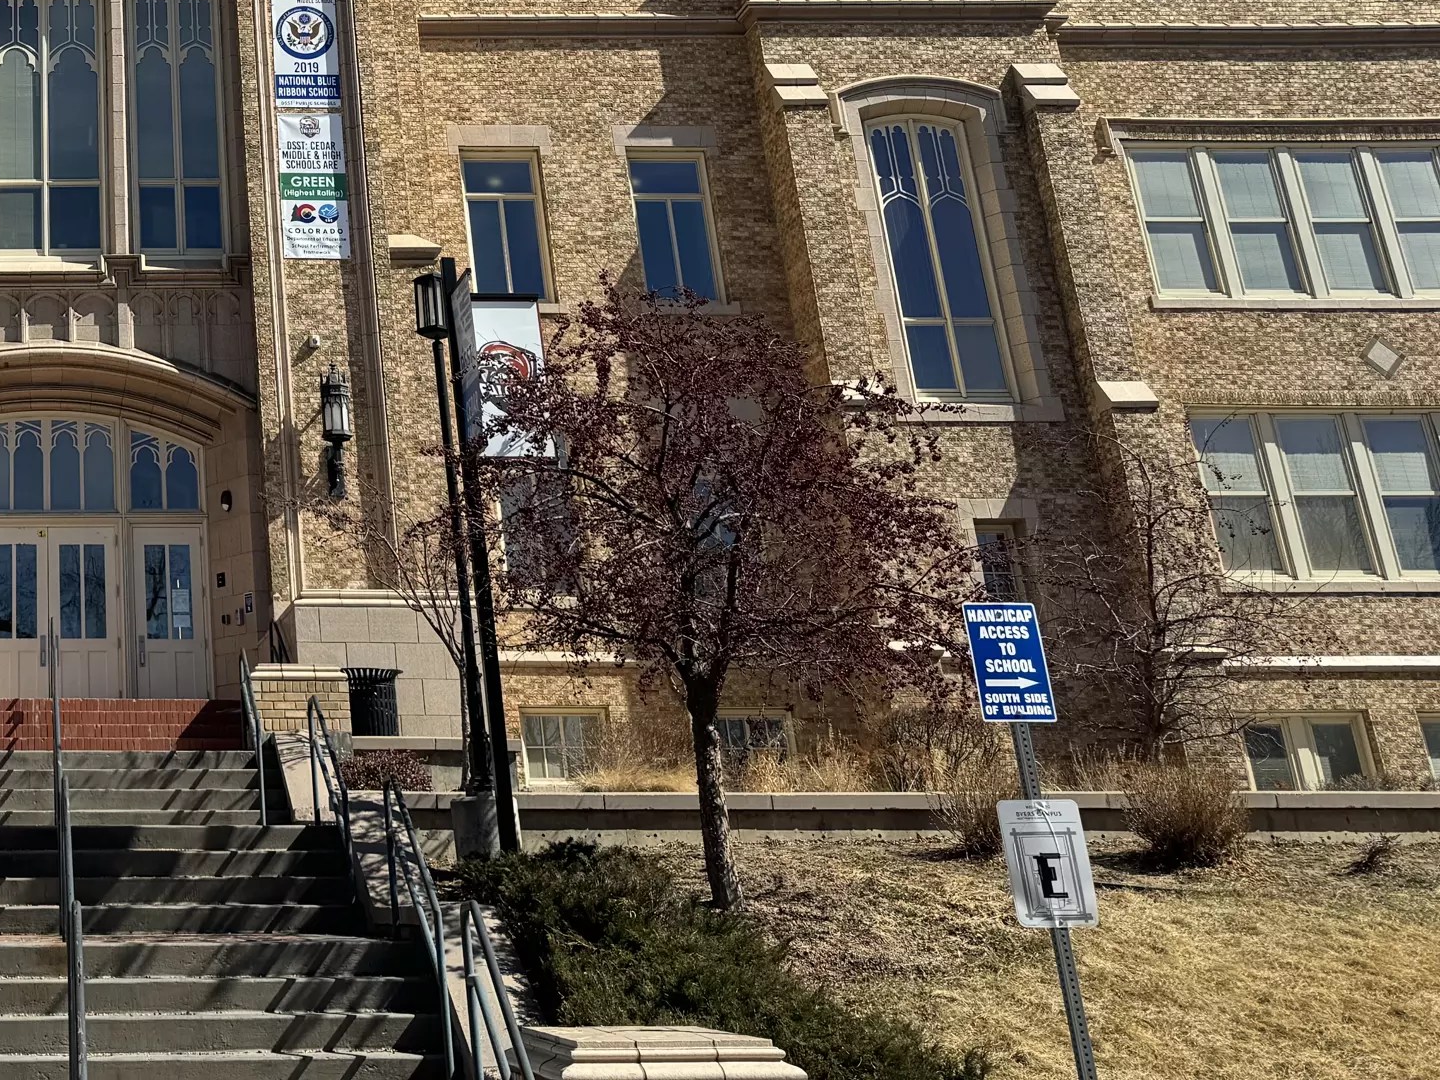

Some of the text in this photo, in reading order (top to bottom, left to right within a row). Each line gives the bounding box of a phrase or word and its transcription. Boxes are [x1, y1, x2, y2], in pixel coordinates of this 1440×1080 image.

[293, 61, 319, 73] 2019
[278, 76, 336, 86] NATIONAL BLUE
[278, 87, 339, 97] RIBBON SCHOOL
[286, 141, 336, 151] DSST: CEDAR
[281, 150, 342, 160] MIDDLE & HIGH
[286, 160, 339, 170] SCHOOLS ARE
[290, 176, 335, 187] GREEN
[284, 189, 344, 198] (Highest Rating)
[288, 227, 344, 235] COLORADO
[966, 609, 1033, 622] HANDICAP
[979, 625, 1030, 639] ACCESS
[998, 642, 1016, 656] TO
[984, 658, 1037, 673] SCHOOL
[984, 693, 1049, 703] SOUTH SIDE
[985, 705, 999, 715] OF
